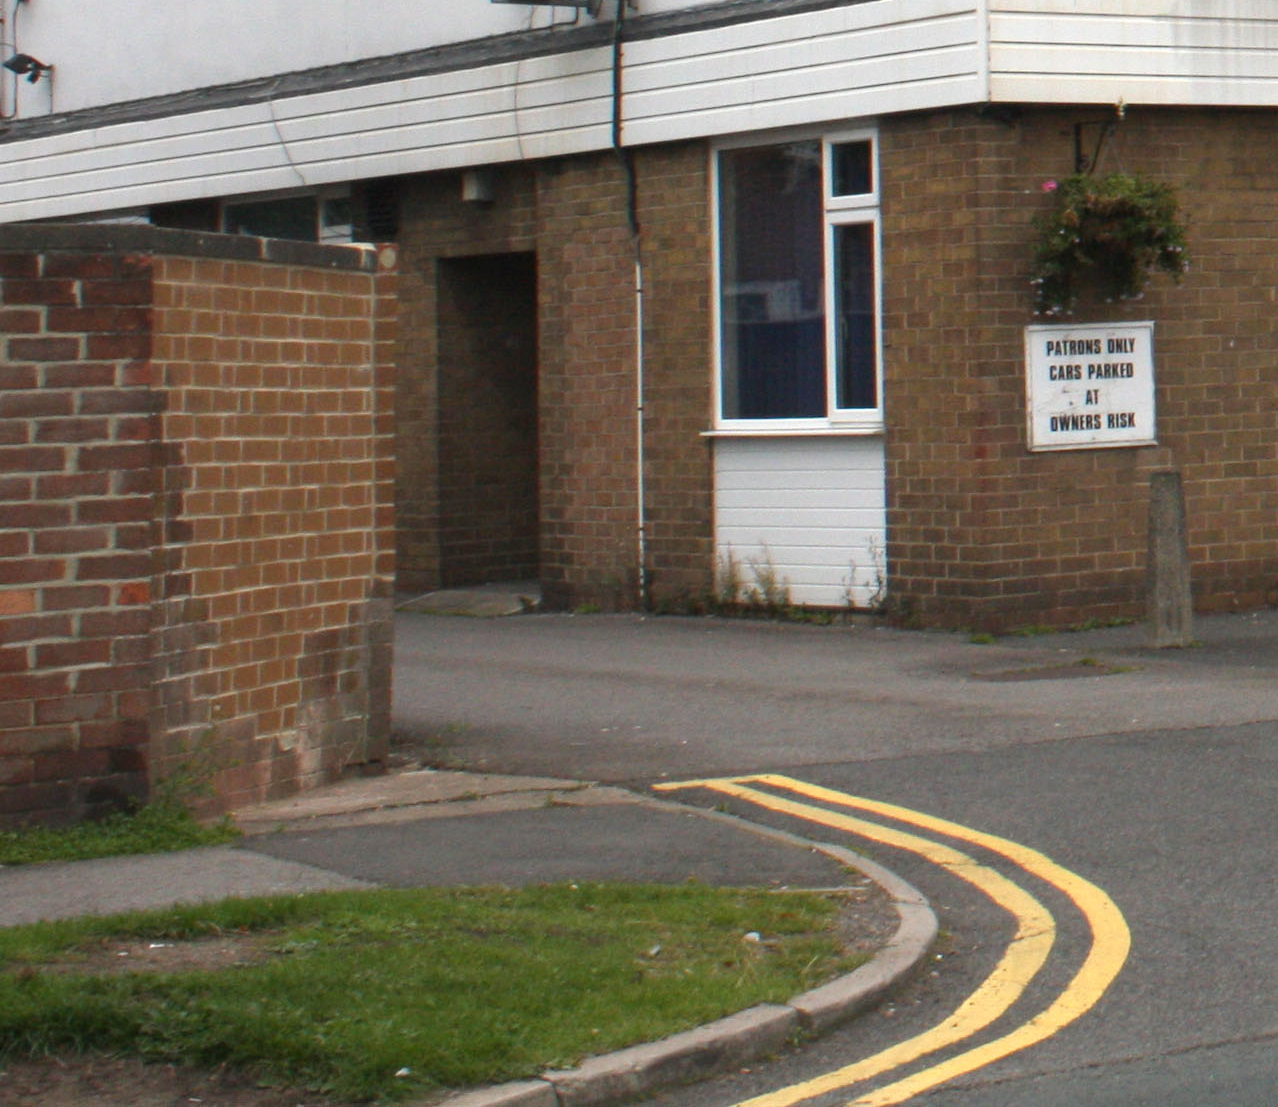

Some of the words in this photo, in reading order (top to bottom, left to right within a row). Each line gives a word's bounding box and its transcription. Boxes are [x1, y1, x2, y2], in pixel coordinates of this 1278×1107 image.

[1046, 339, 1101, 357] PATRONS
[1107, 338, 1135, 354] ONLY
[1049, 364, 1082, 381] CARS
[1088, 363, 1134, 380] PARKED
[1085, 389, 1100, 405] AT
[1050, 414, 1101, 432] OWNERS
[1107, 412, 1136, 429] RISK
